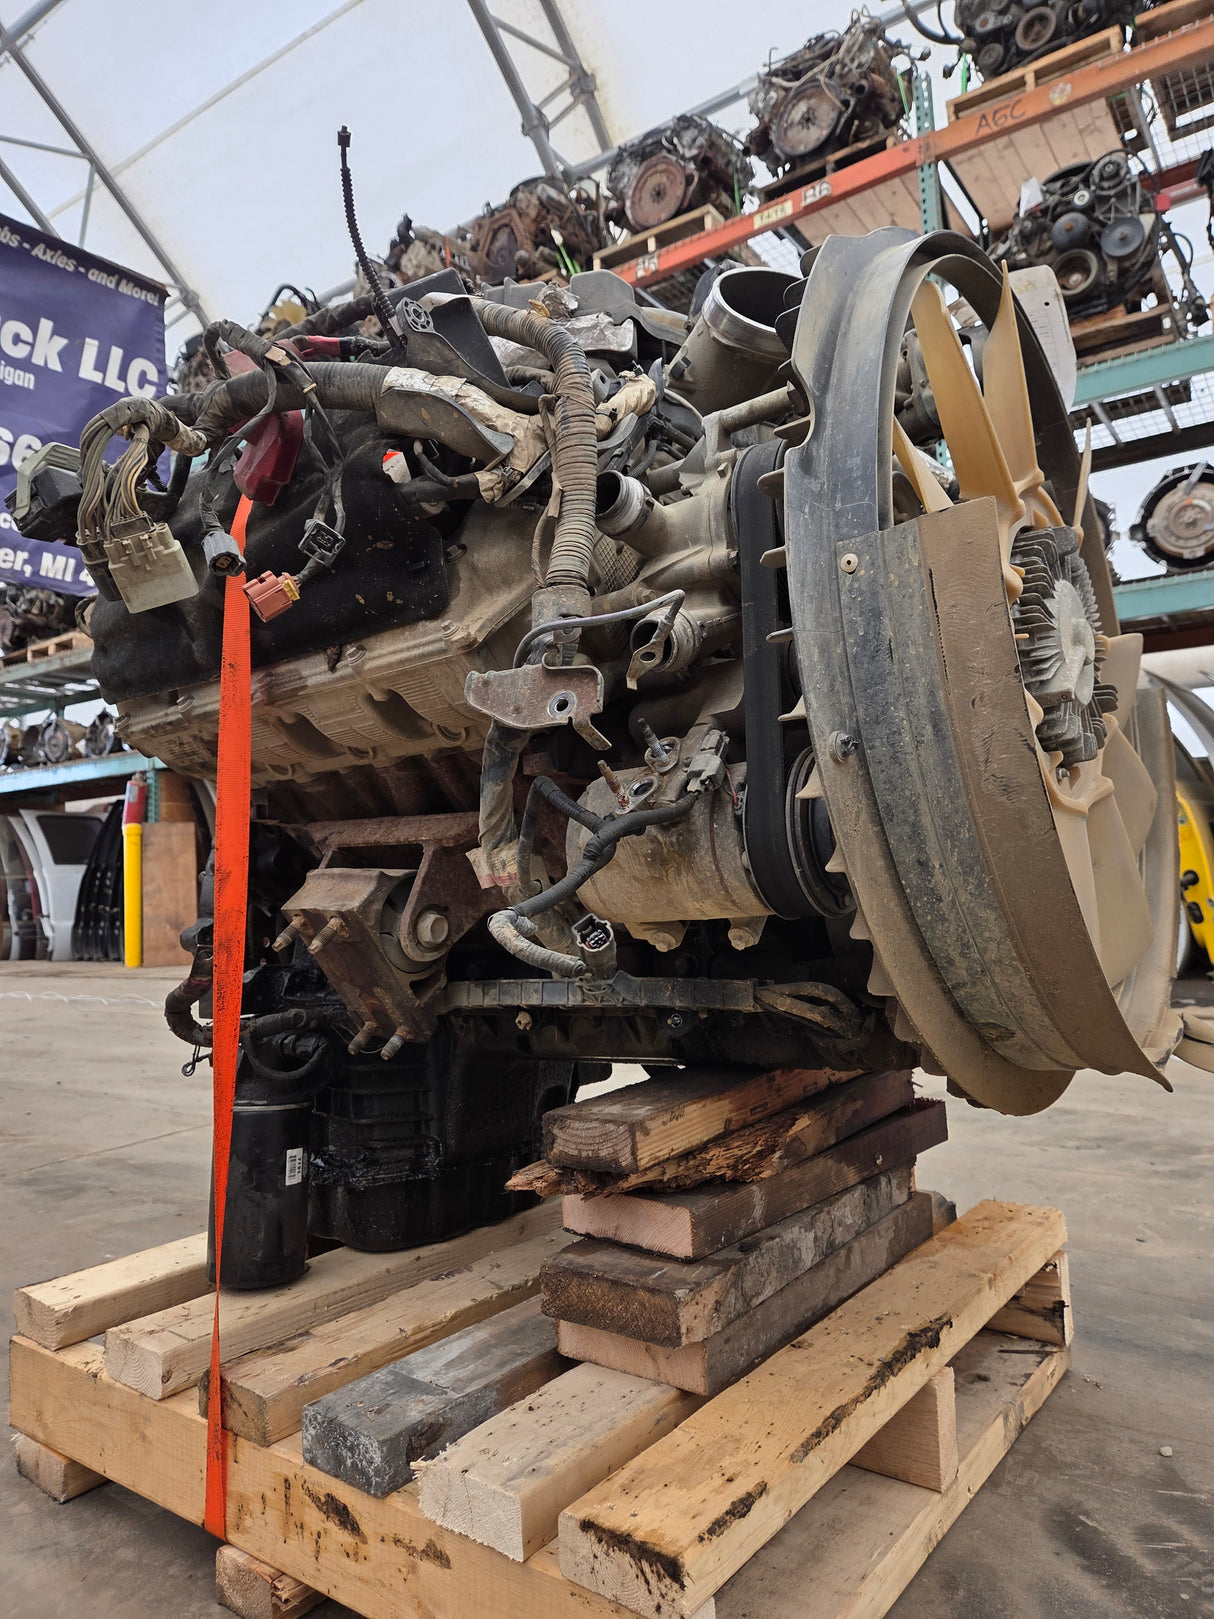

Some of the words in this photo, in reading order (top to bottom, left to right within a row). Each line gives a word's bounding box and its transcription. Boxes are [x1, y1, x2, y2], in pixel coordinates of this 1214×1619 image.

[0, 225, 21, 248] bs
[31, 243, 77, 272] Axles
[87, 268, 119, 290] and
[118, 278, 160, 307] More!
[0, 316, 69, 373] ck
[78, 337, 160, 400] LLC
[0, 360, 35, 390] igan
[0, 547, 33, 578] er,
[39, 551, 76, 582] MI
[79, 567, 96, 587] 4
